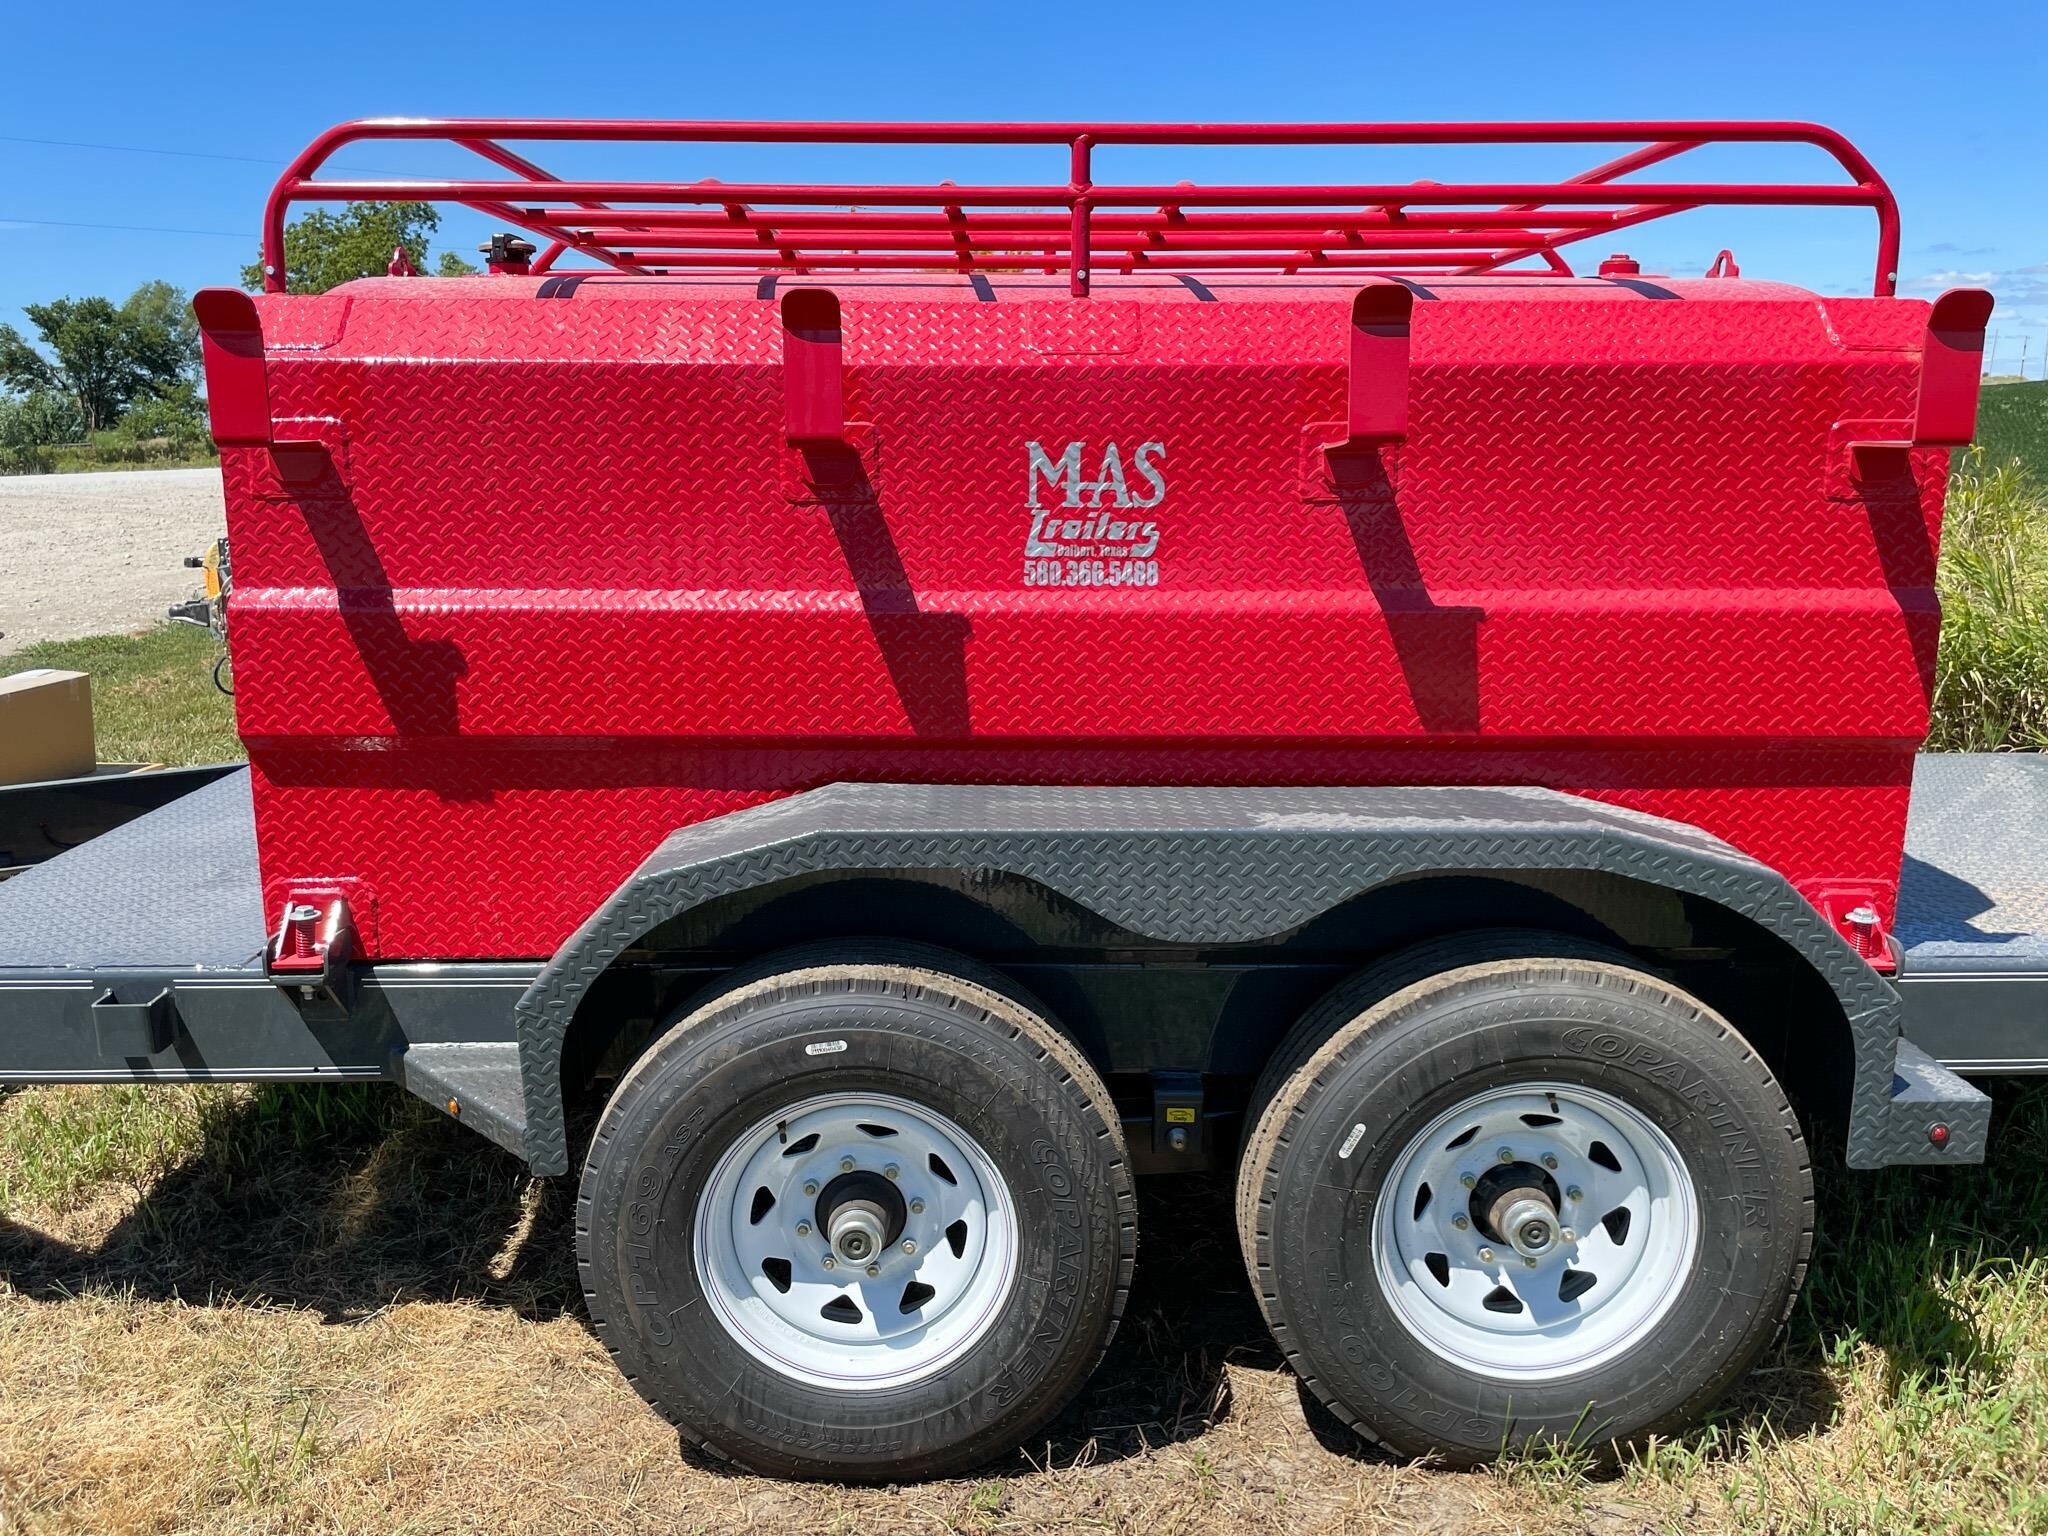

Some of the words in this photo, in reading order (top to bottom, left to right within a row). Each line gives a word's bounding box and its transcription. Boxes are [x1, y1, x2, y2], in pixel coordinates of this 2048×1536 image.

[1024, 441, 1166, 508] MAS
[1024, 509, 1160, 557] Trailers
[1099, 544, 1129, 557] Texas
[1023, 560, 1160, 587] 580.366.5488
[986, 1138, 1085, 1407] COPARTNER
